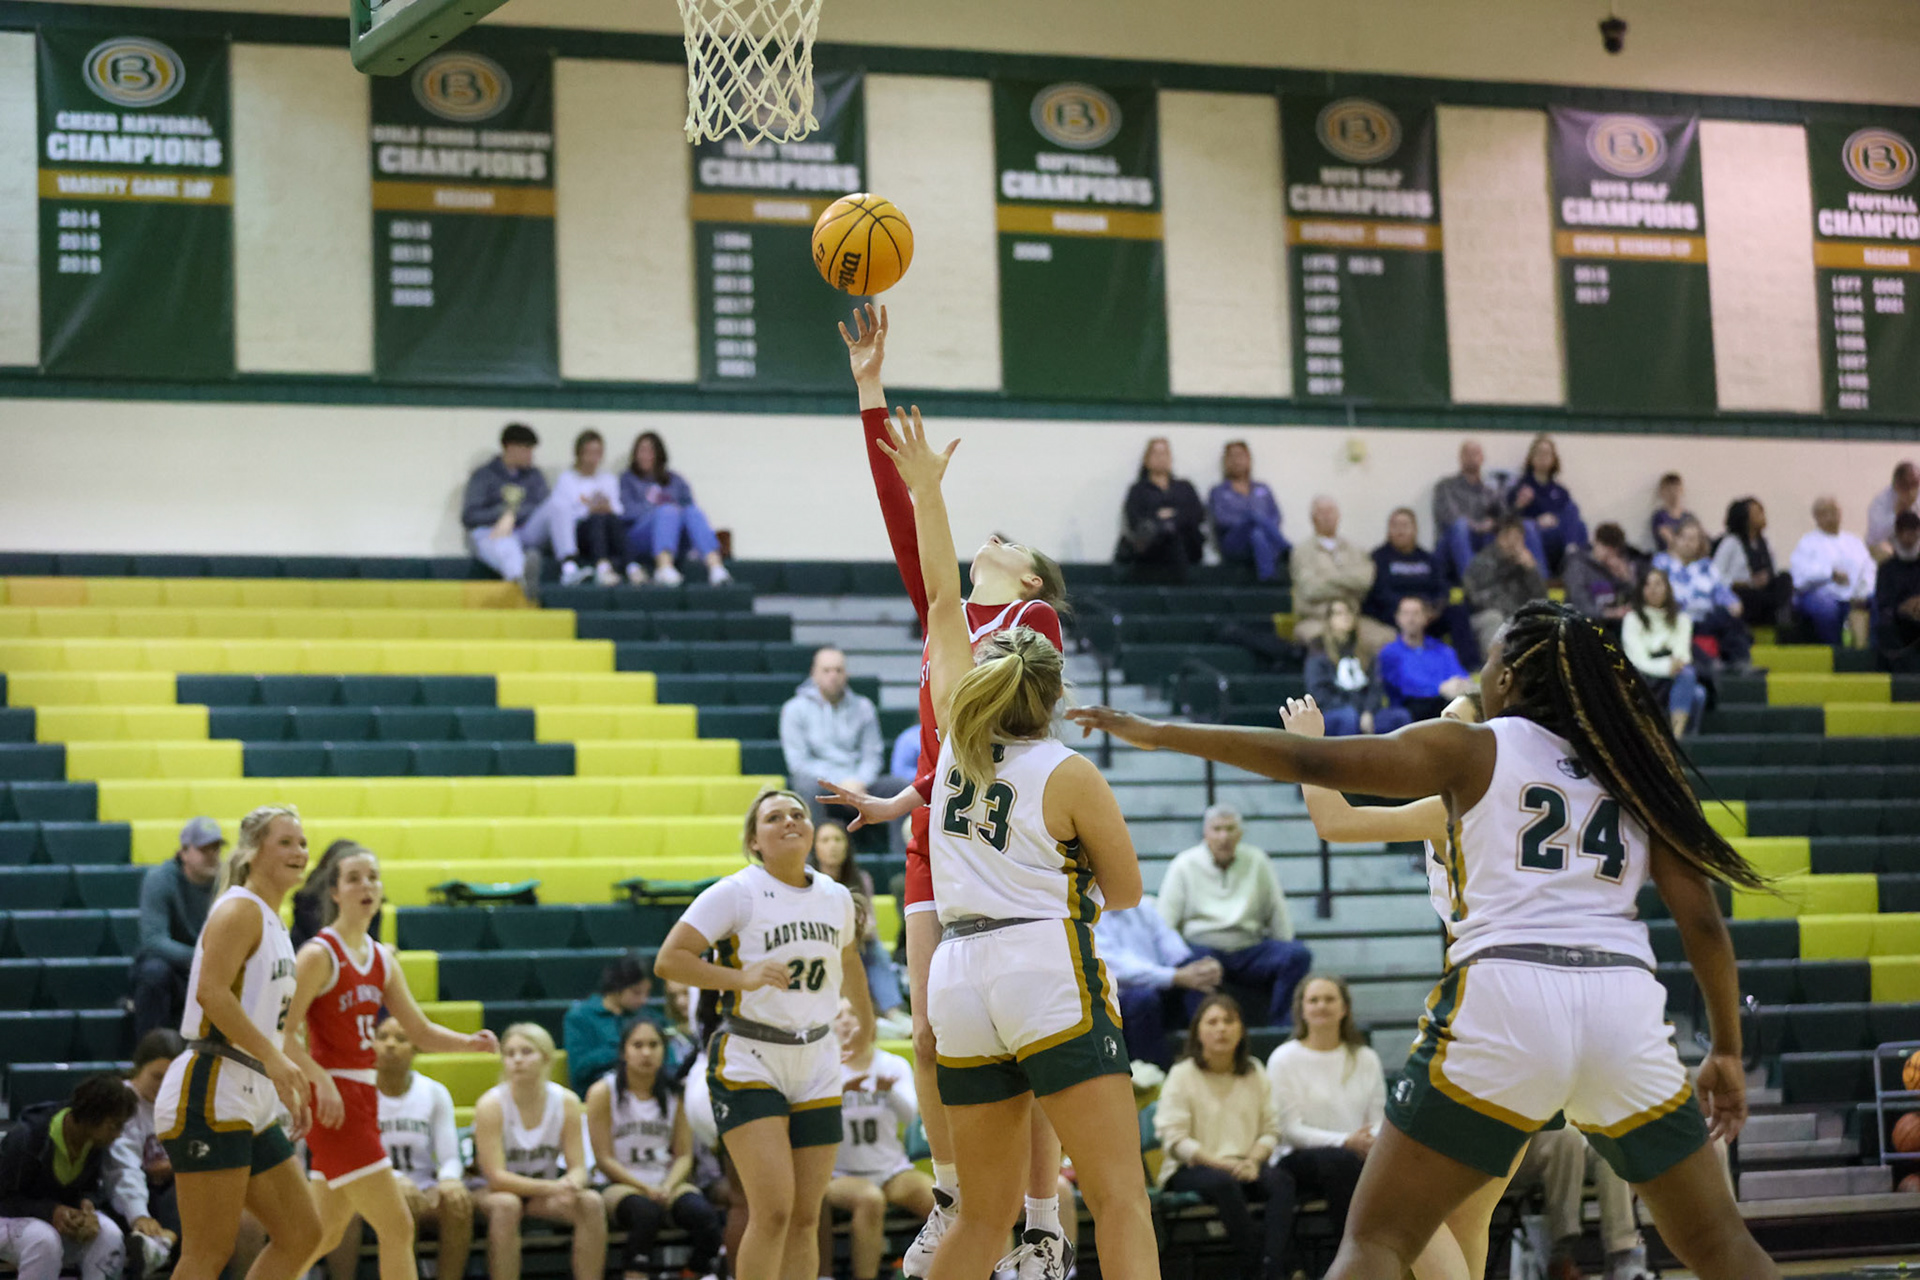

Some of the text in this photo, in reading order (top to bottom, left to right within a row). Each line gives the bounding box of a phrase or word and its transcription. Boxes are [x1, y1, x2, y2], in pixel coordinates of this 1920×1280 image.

[46, 132, 222, 167] CHAMPIONS
[379, 145, 547, 180] CHAMPIONS
[700, 157, 862, 193] CHAMPIONS
[1001, 168, 1154, 206] CHAMPIONS
[1288, 183, 1434, 219] CHAMPIONS
[1561, 196, 1699, 231] CHAMPIONS
[941, 764, 1018, 854] 23
[1515, 782, 1629, 885] 24
[764, 922, 798, 953] LADY
[786, 956, 828, 993] 20
[849, 1118, 878, 1147] 10
